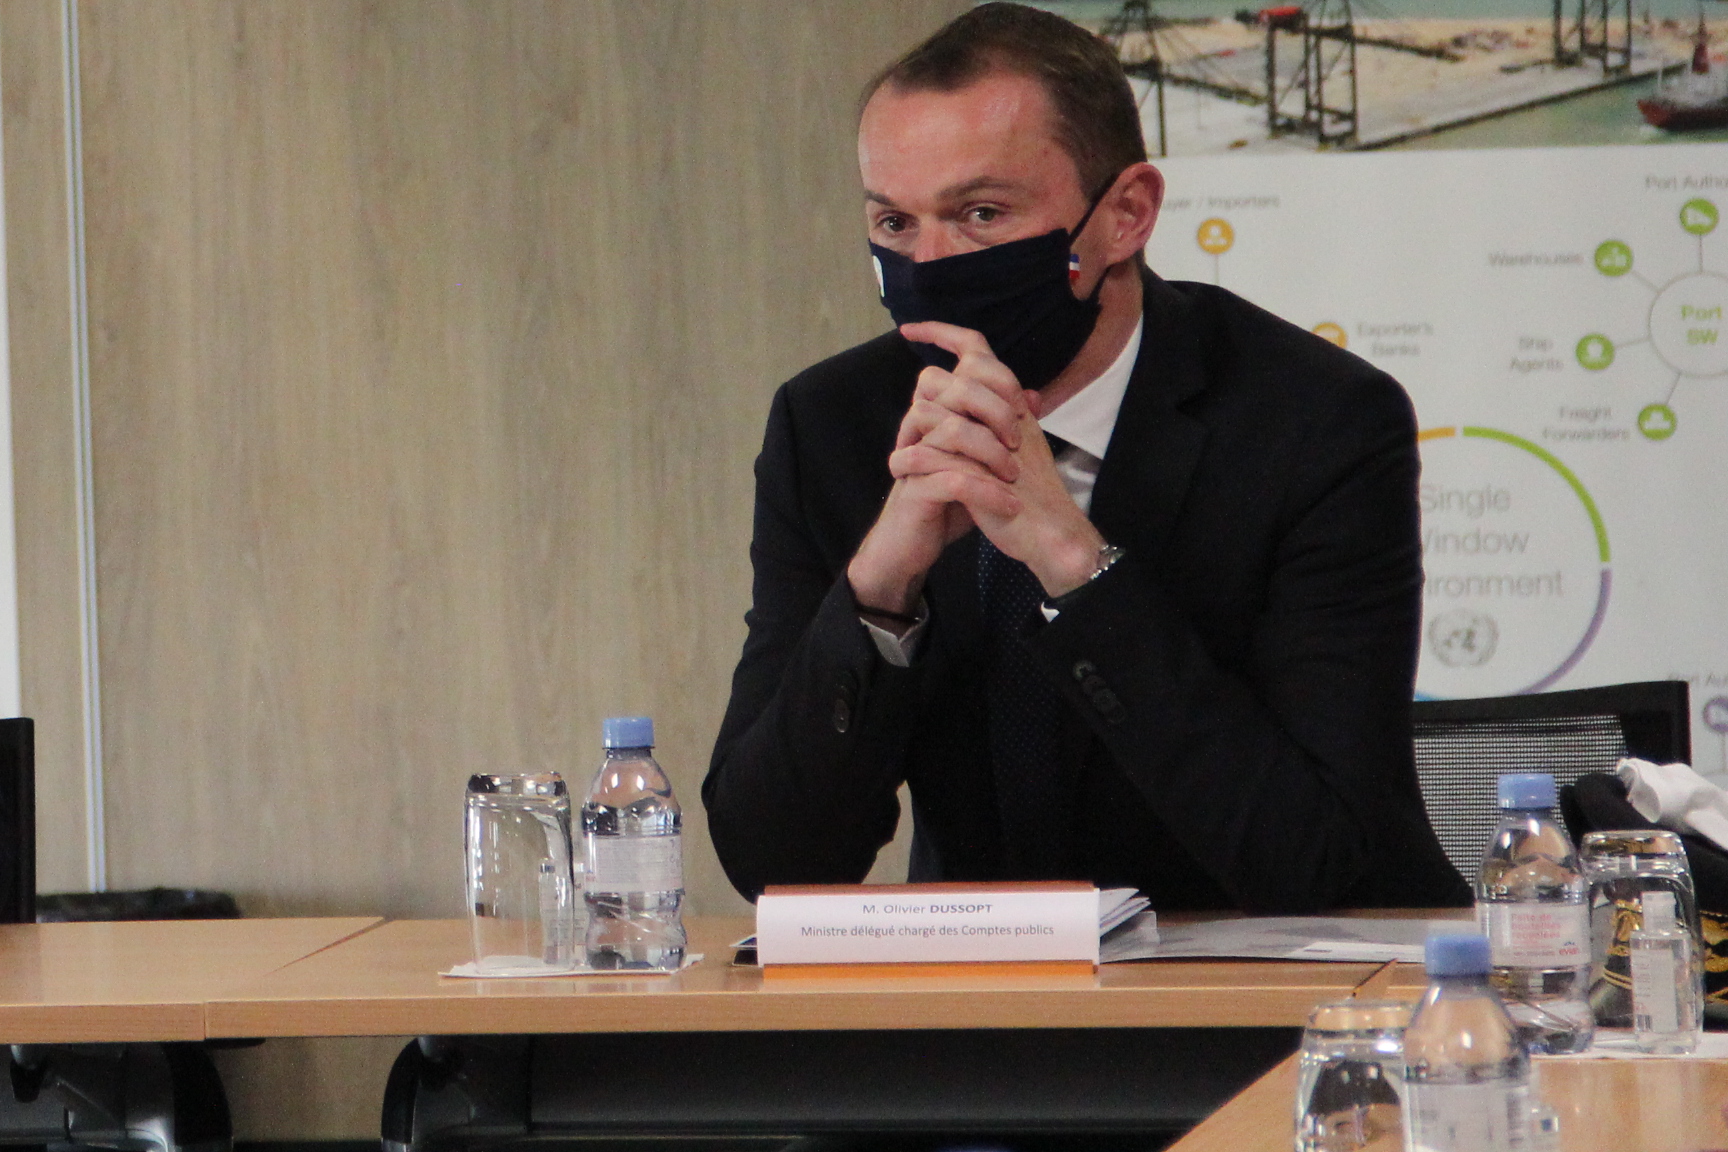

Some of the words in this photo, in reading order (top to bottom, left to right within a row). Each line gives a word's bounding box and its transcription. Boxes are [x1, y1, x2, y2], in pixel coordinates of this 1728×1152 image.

[1680, 304, 1723, 321] Port
[1420, 483, 1511, 519] Single
[1425, 570, 1565, 598] ironment
[863, 904, 880, 914] M.
[883, 904, 926, 914] Olivier
[929, 904, 993, 914] DUSSOPT
[801, 926, 848, 937] Ministre
[850, 925, 895, 939] délégué
[898, 925, 936, 938] chargé
[939, 925, 959, 936] des
[961, 925, 1012, 938] Comptes
[1015, 924, 1054, 937] publics
